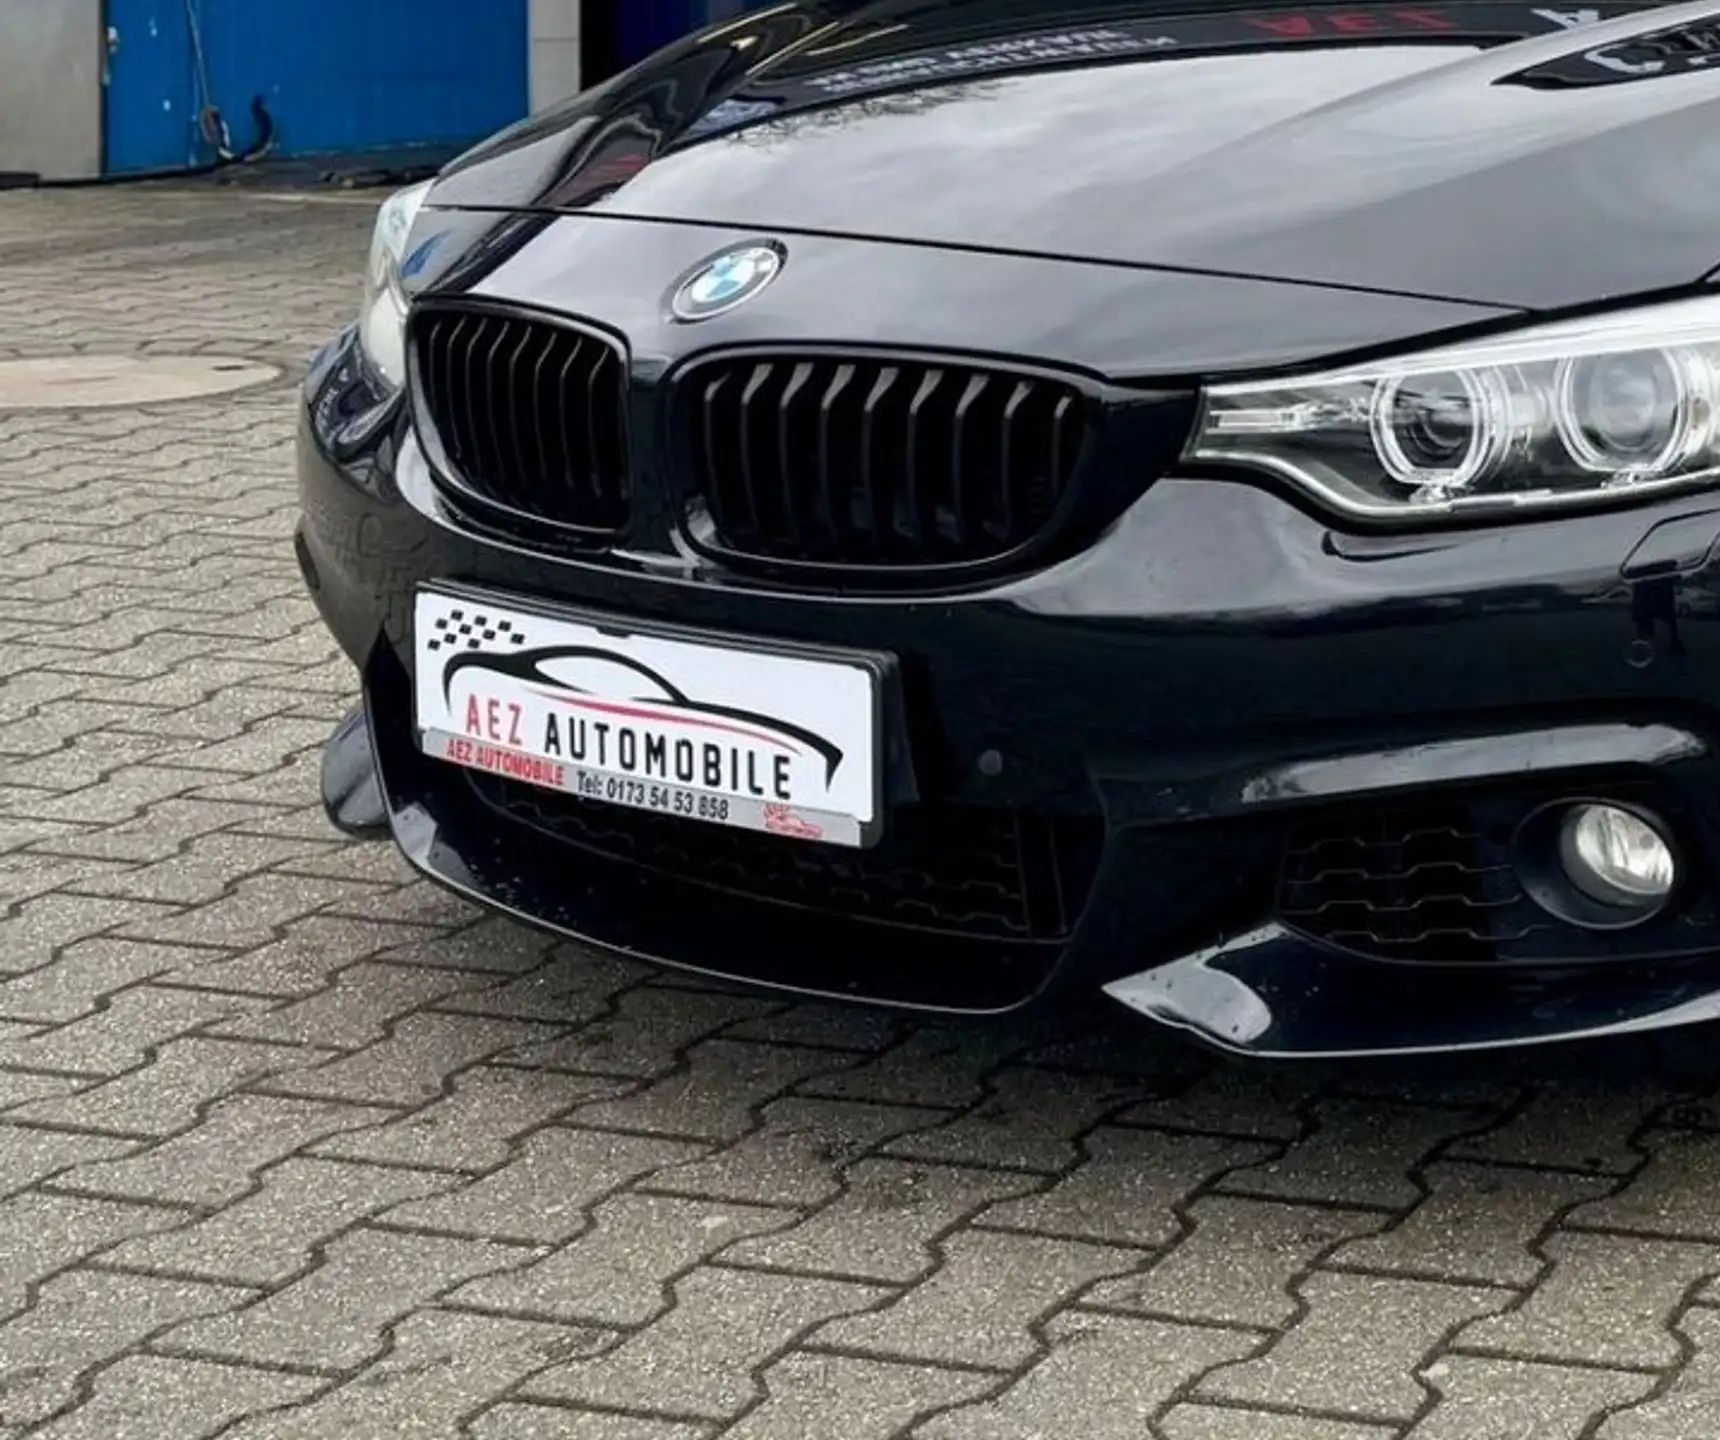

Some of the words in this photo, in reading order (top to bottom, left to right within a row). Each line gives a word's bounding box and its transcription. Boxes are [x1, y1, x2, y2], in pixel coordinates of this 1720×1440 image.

[446, 739, 476, 762] AEZ
[476, 745, 566, 786] AUTOMOBILE
[576, 770, 602, 796] Tel:
[606, 776, 646, 806] 0173
[649, 785, 670, 810] 54
[673, 791, 694, 816] 53
[466, 693, 523, 746] AEZ
[544, 712, 792, 800] AUTOMOBILE
